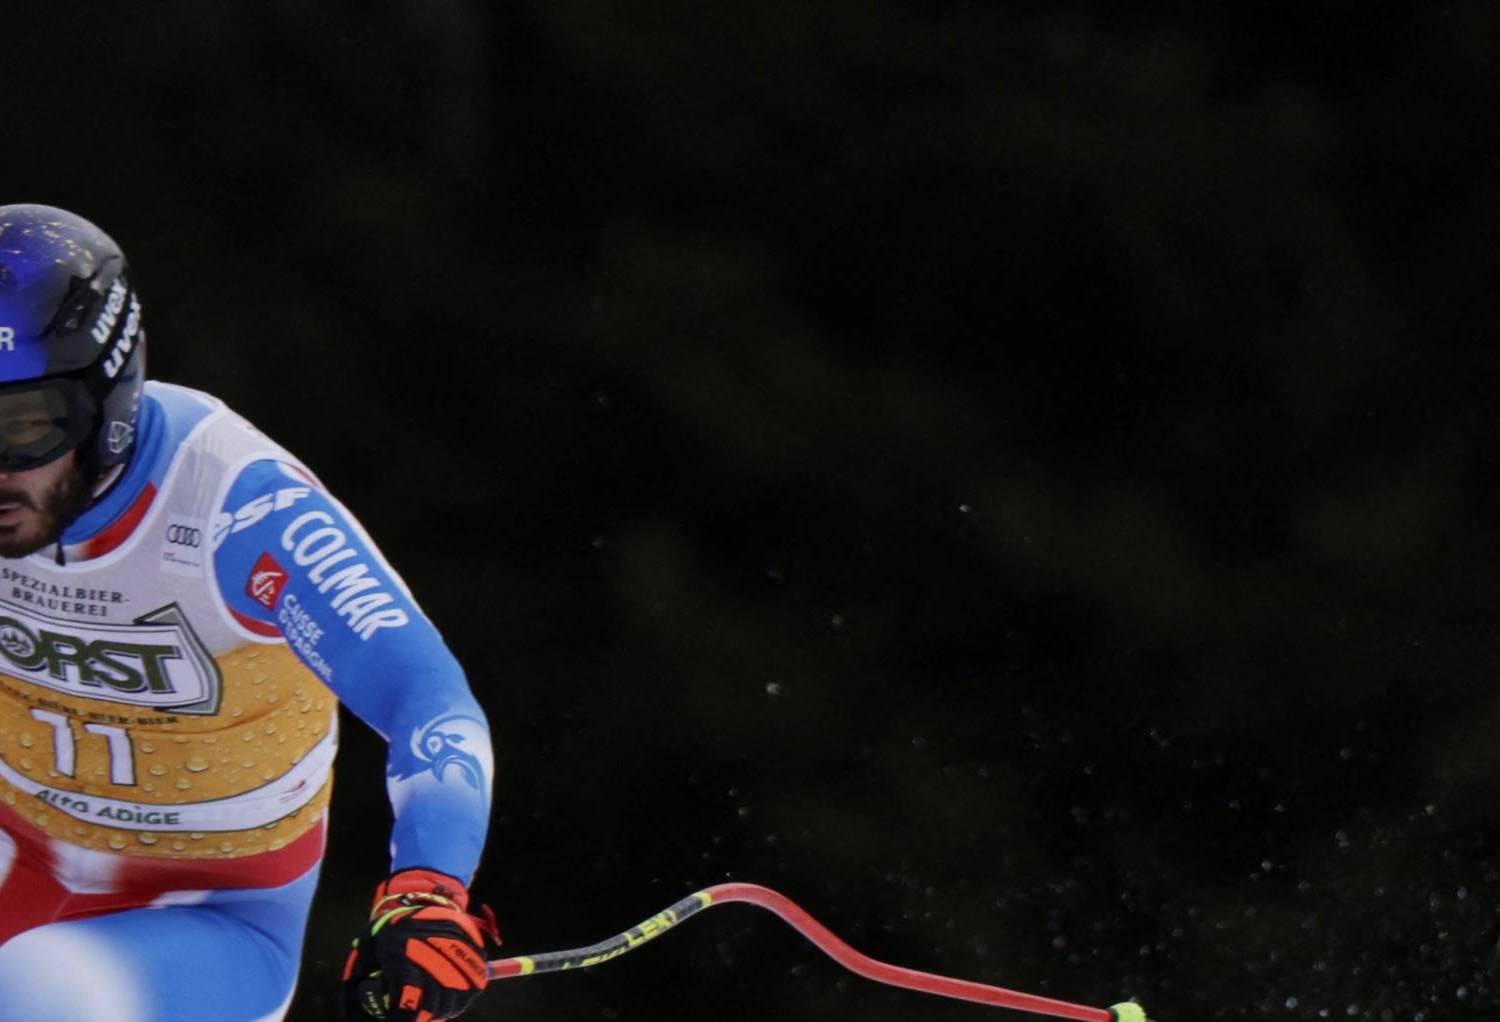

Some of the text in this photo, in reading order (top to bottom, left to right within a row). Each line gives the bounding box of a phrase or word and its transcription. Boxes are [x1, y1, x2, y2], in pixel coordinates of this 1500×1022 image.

[91, 278, 127, 344] uvex
[11, 586, 108, 617] BRAUEREI
[281, 511, 408, 640] COLMAR
[283, 594, 325, 646] CAISSE
